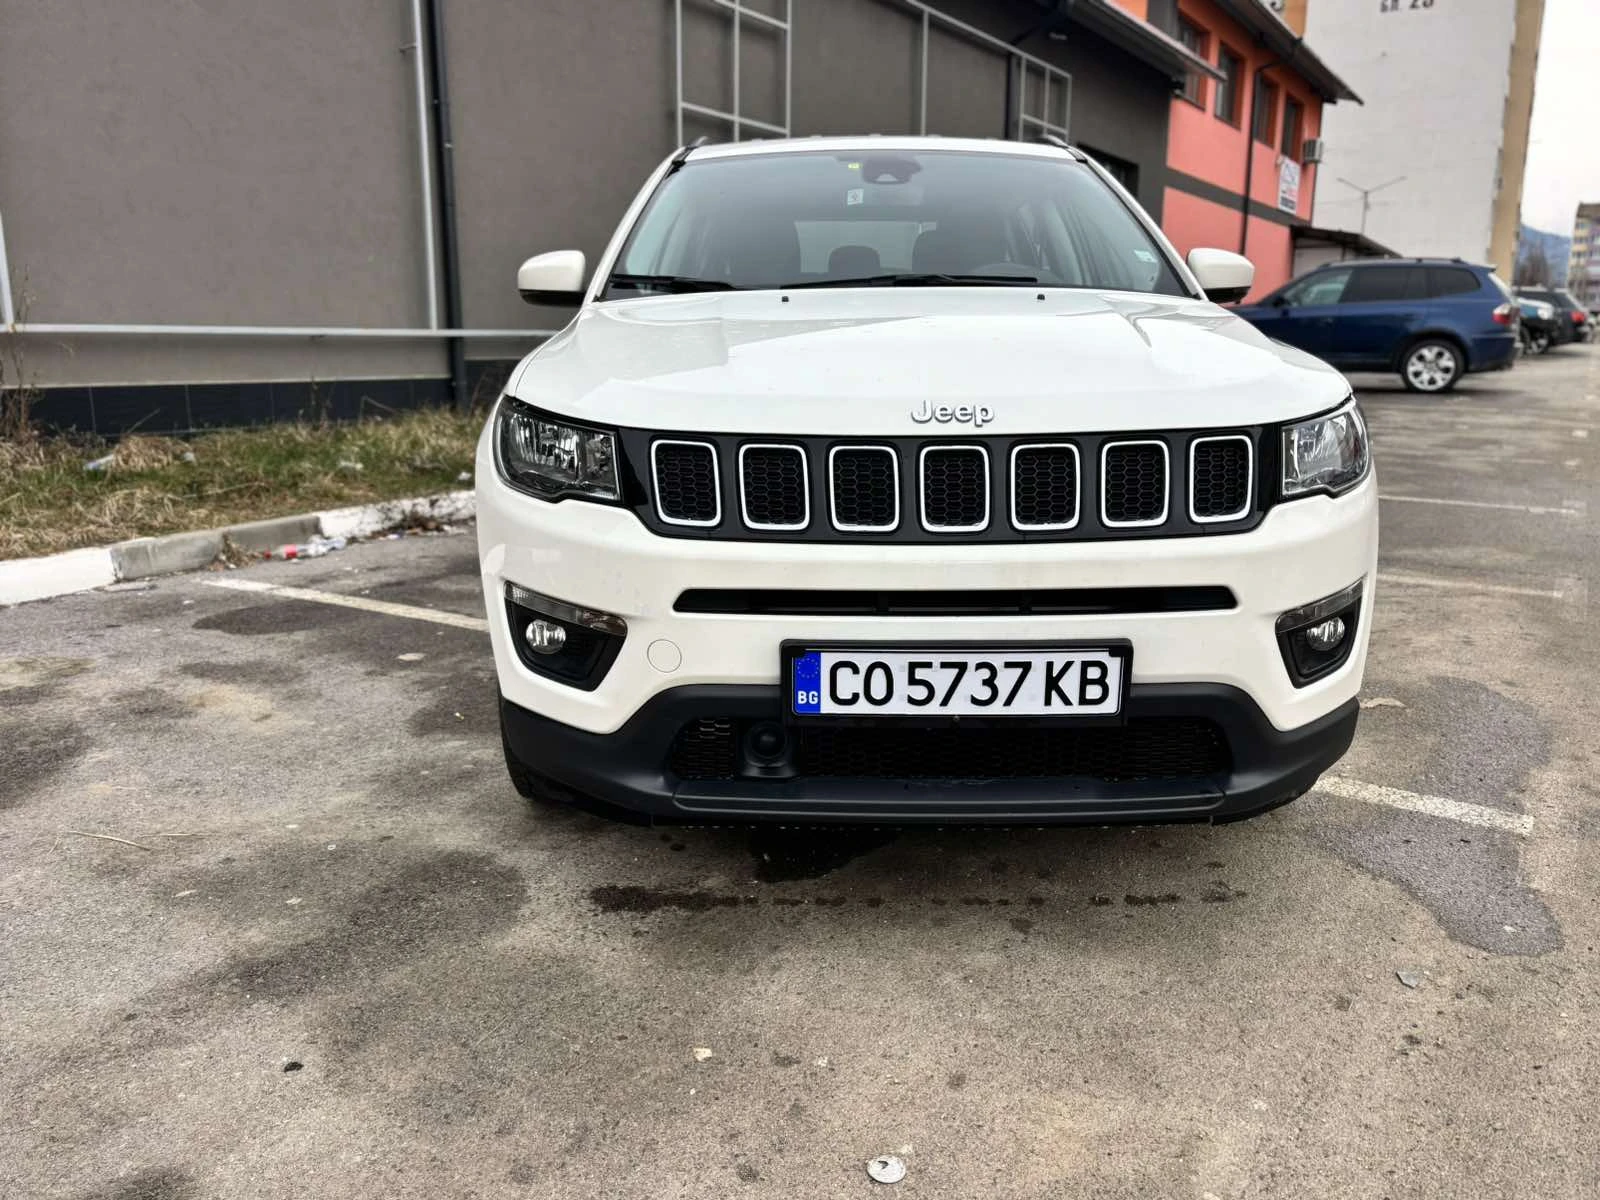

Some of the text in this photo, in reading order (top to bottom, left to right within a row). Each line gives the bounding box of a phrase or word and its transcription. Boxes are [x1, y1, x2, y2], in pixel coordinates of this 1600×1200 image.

[911, 400, 994, 428] Jeep
[797, 690, 819, 705] BG
[906, 660, 1032, 708] 5737
[1044, 659, 1110, 707] KB
